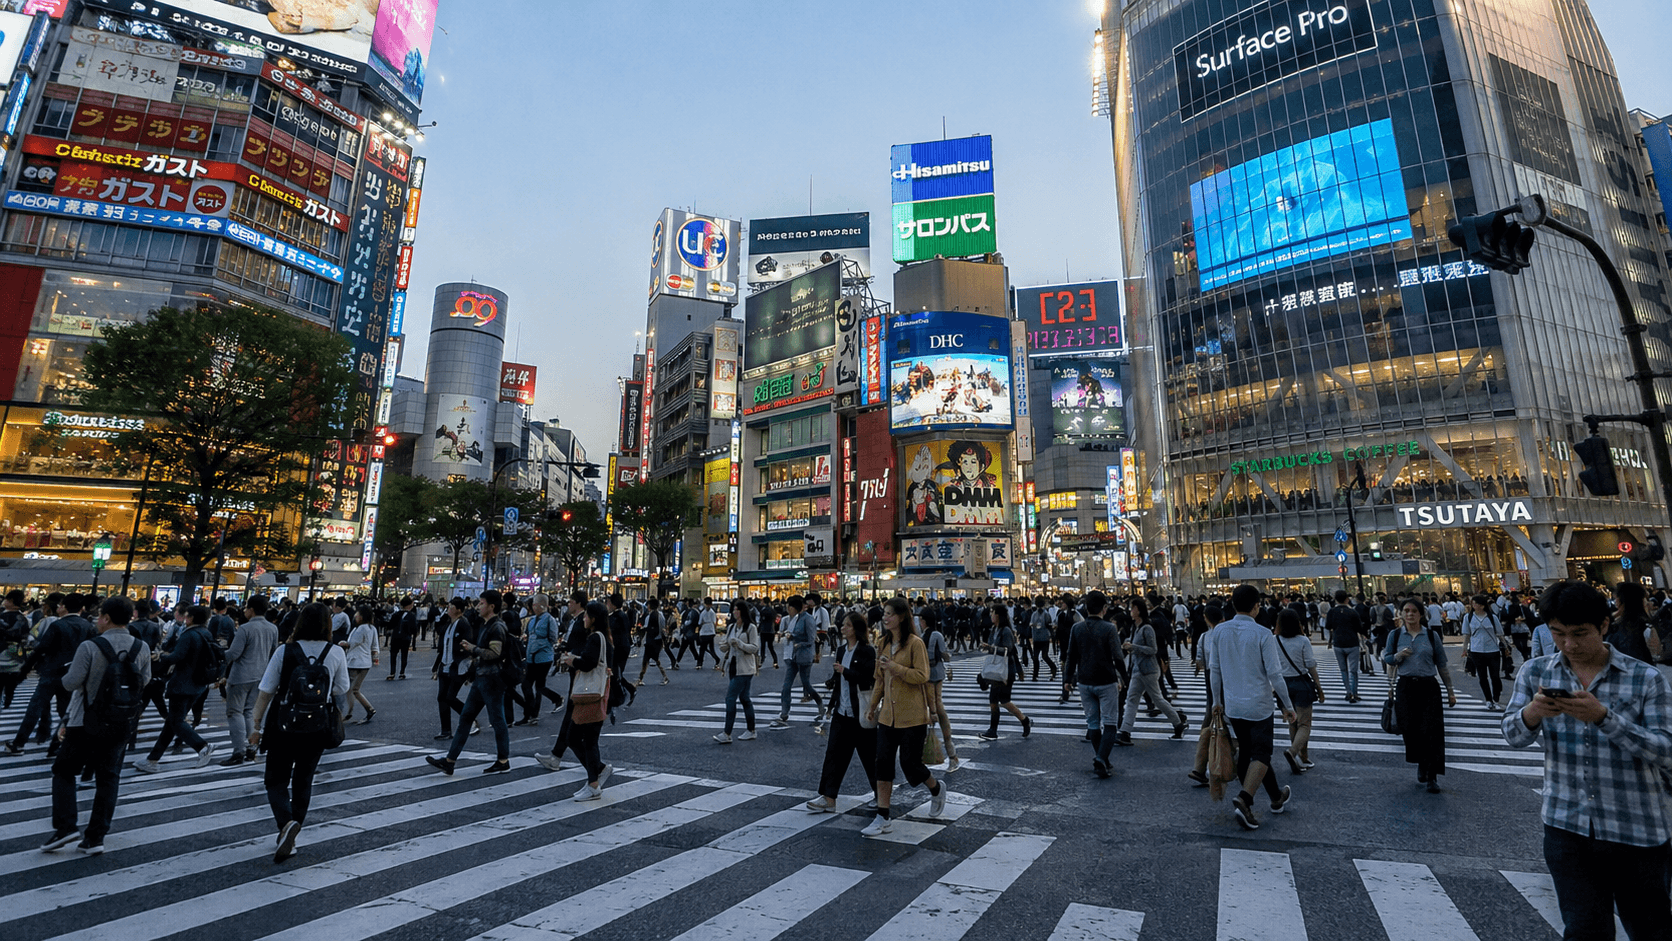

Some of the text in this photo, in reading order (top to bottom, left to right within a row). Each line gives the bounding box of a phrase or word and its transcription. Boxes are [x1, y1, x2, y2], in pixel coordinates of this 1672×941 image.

[1196, 5, 1348, 77] Surface Pro
[143, 154, 208, 178] ガスト
[99, 176, 184, 207] ガスト
[303, 198, 341, 227] ガスト
[897, 212, 991, 239] サロンパス
[929, 333, 964, 349] DHC
[1231, 441, 1420, 475] STARBUCKS COFFEE
[1399, 501, 1532, 527] TSUTAYA
